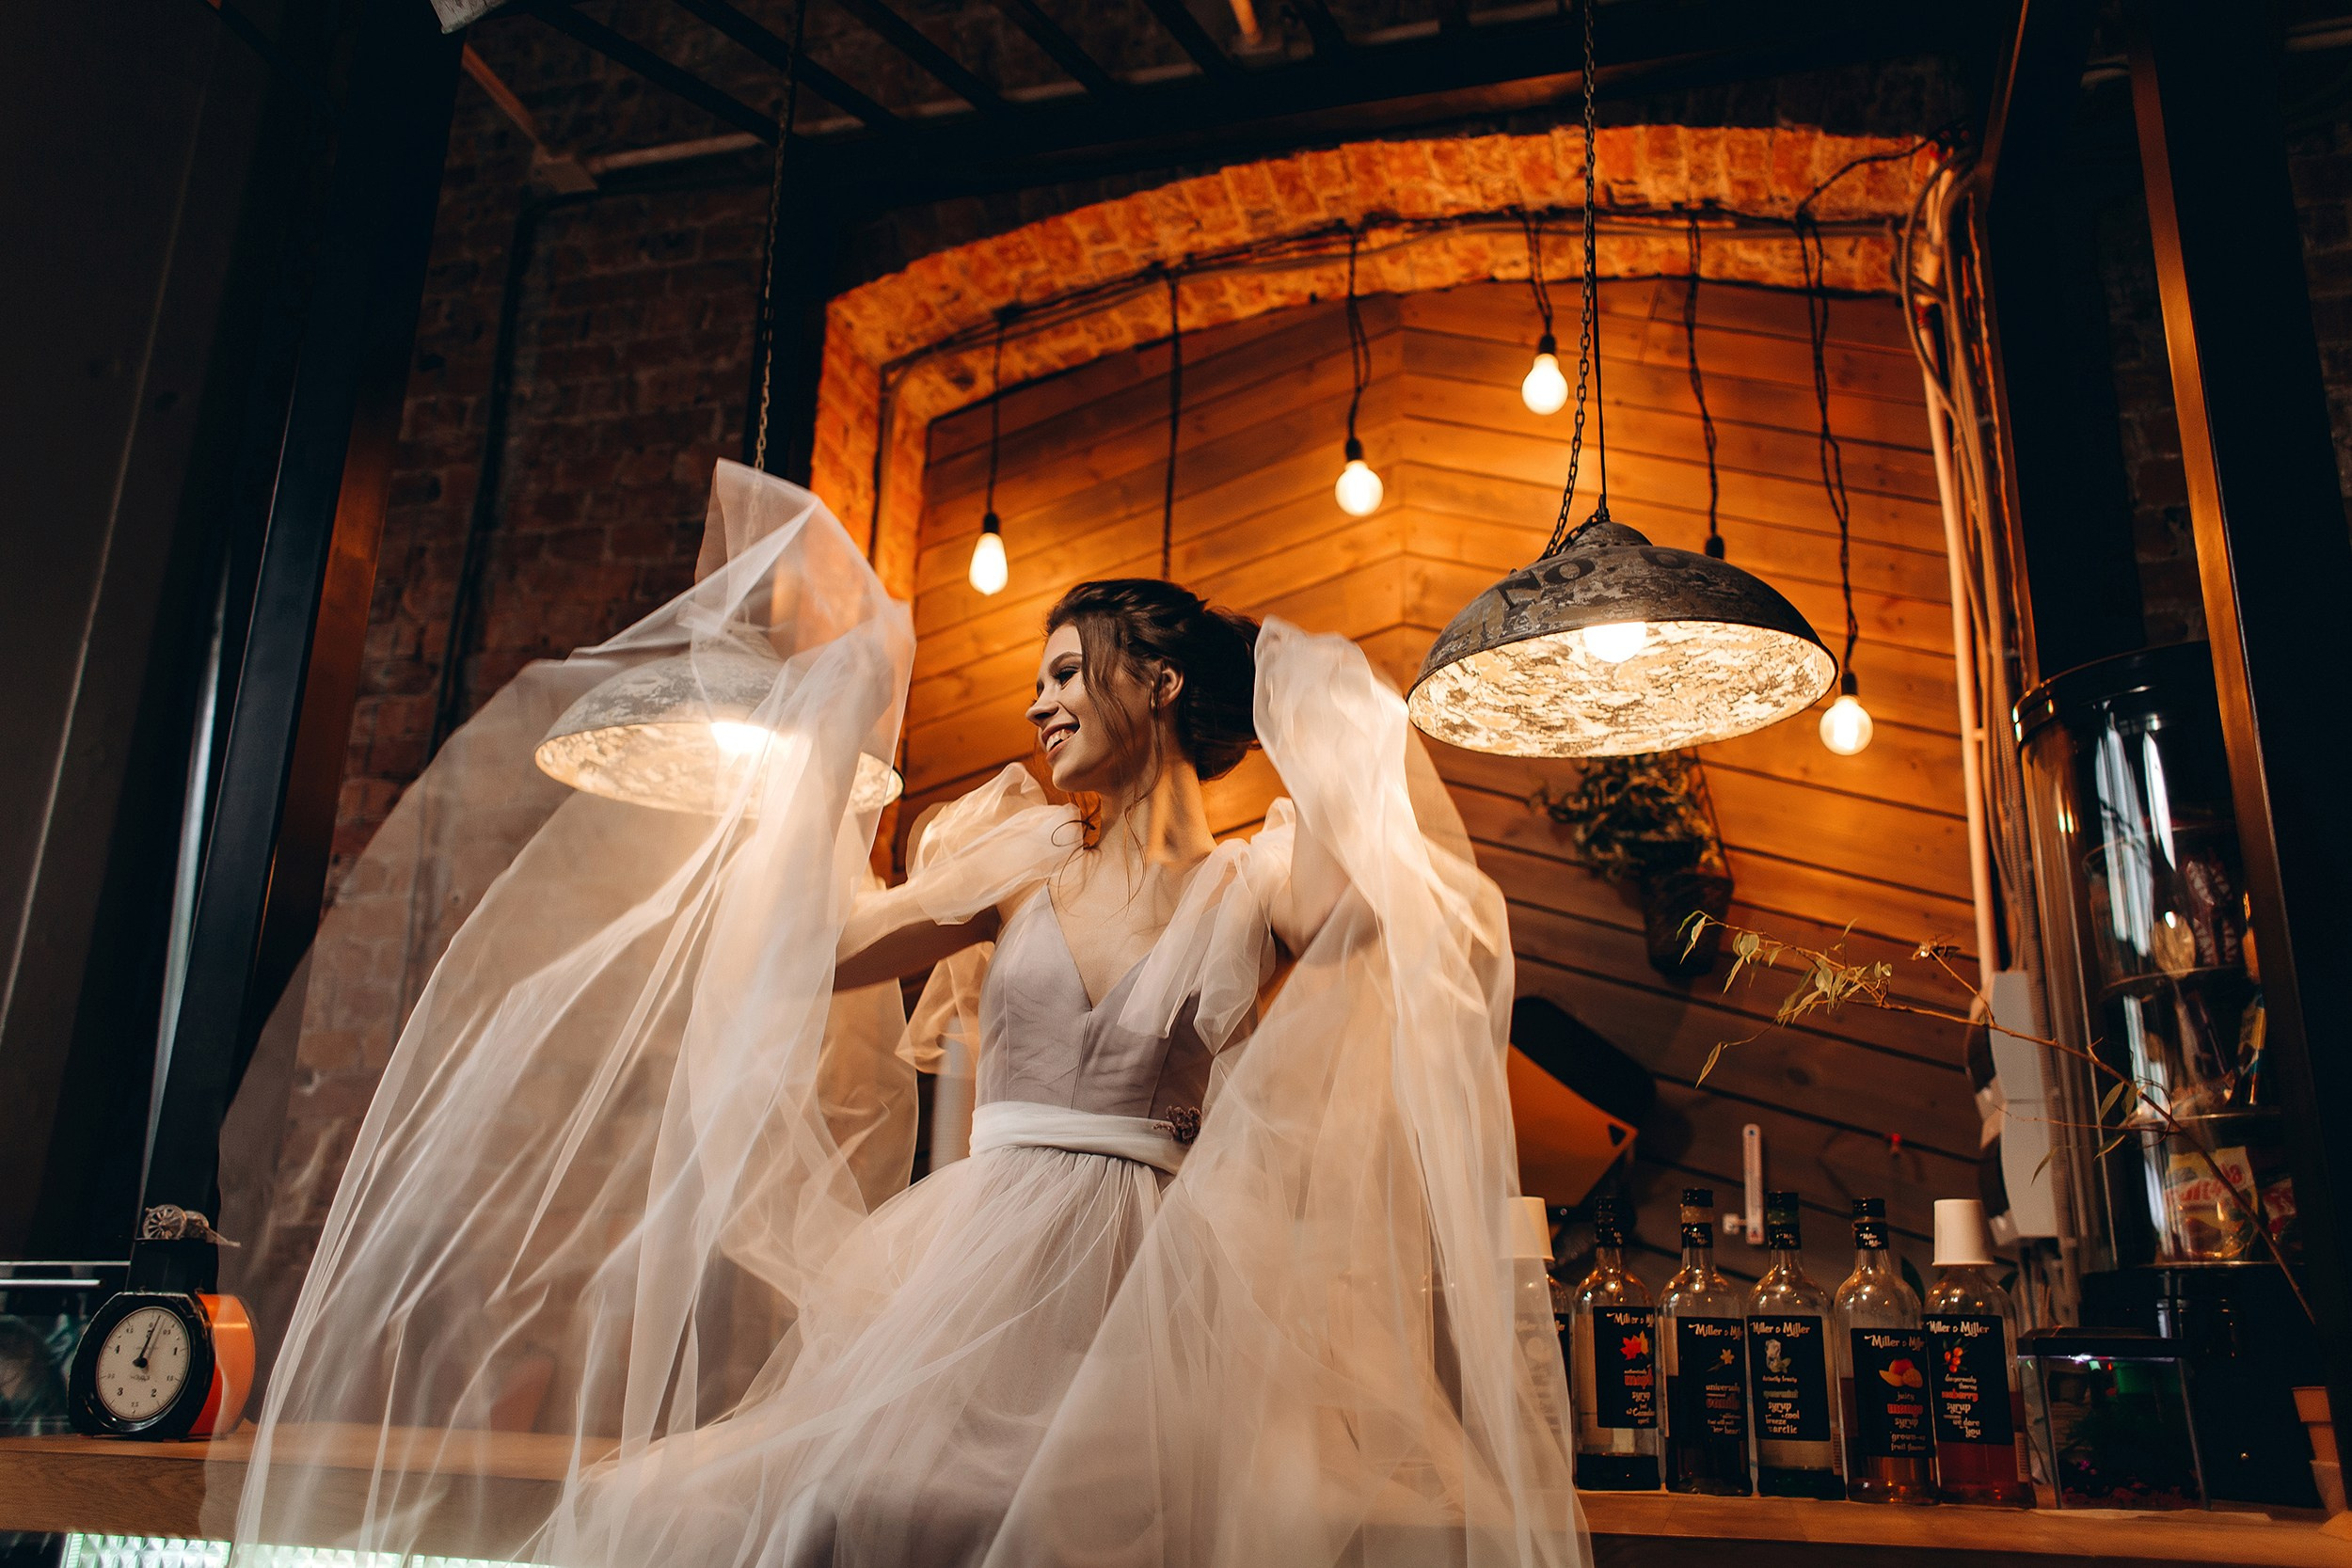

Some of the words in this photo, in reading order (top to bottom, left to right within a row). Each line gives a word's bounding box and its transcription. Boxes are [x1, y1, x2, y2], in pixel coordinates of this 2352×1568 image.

[1606, 1312, 1639, 1326] Miller
[1688, 1323, 1723, 1338] Miller
[1750, 1321, 1774, 1335] Miller
[1783, 1321, 1811, 1338] Miller
[1926, 1320, 1951, 1334] Miller
[1960, 1320, 1990, 1338] Miller
[1864, 1334, 1900, 1349] Miller
[117, 1387, 123, 1396] 3
[151, 1388, 157, 1398] 2
[1768, 1402, 1793, 1414] syrup
[1947, 1402, 1972, 1415] syrup
[1895, 1418, 1919, 1430] syrup
